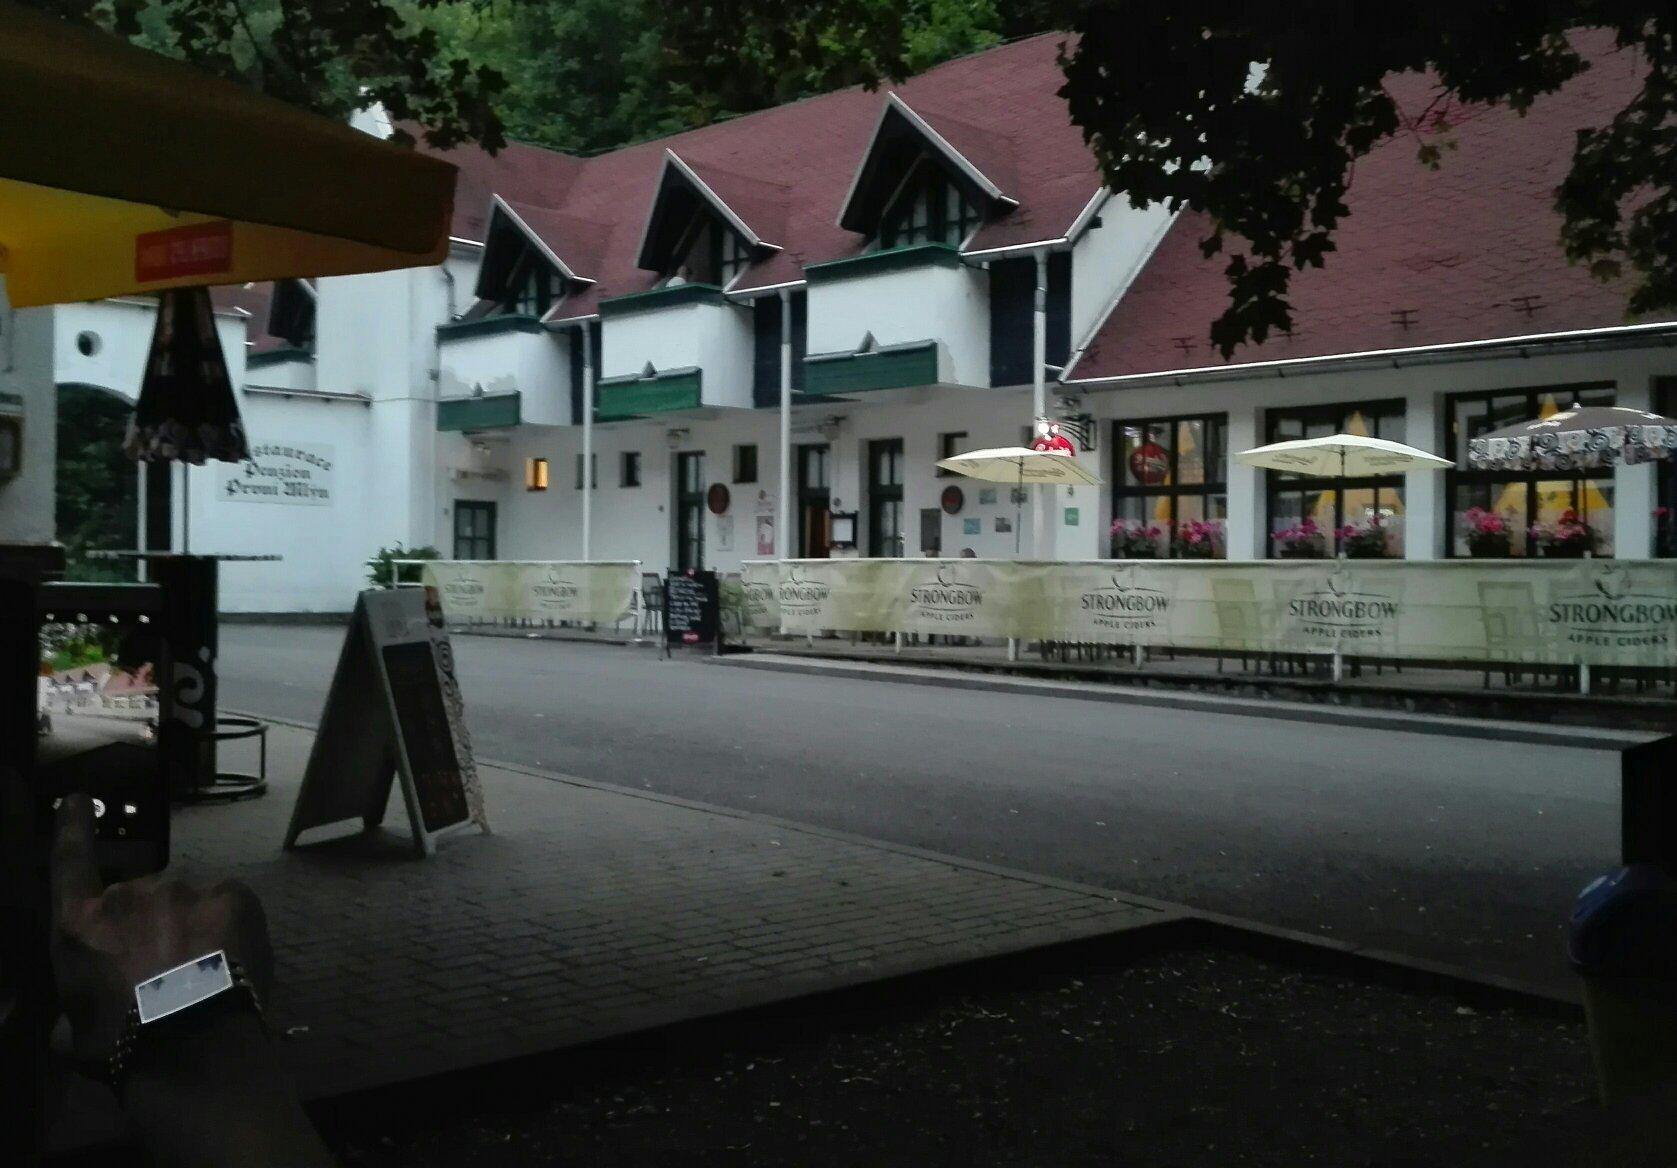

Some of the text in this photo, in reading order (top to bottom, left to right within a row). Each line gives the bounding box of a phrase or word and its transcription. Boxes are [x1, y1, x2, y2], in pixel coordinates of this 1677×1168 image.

[251, 444, 332, 471] staurace
[780, 586, 830, 601] RONGBOW
[911, 588, 983, 605] STRONGBOW
[1081, 593, 1169, 612] STRONGBOW
[1289, 599, 1398, 619] STRONGBOW
